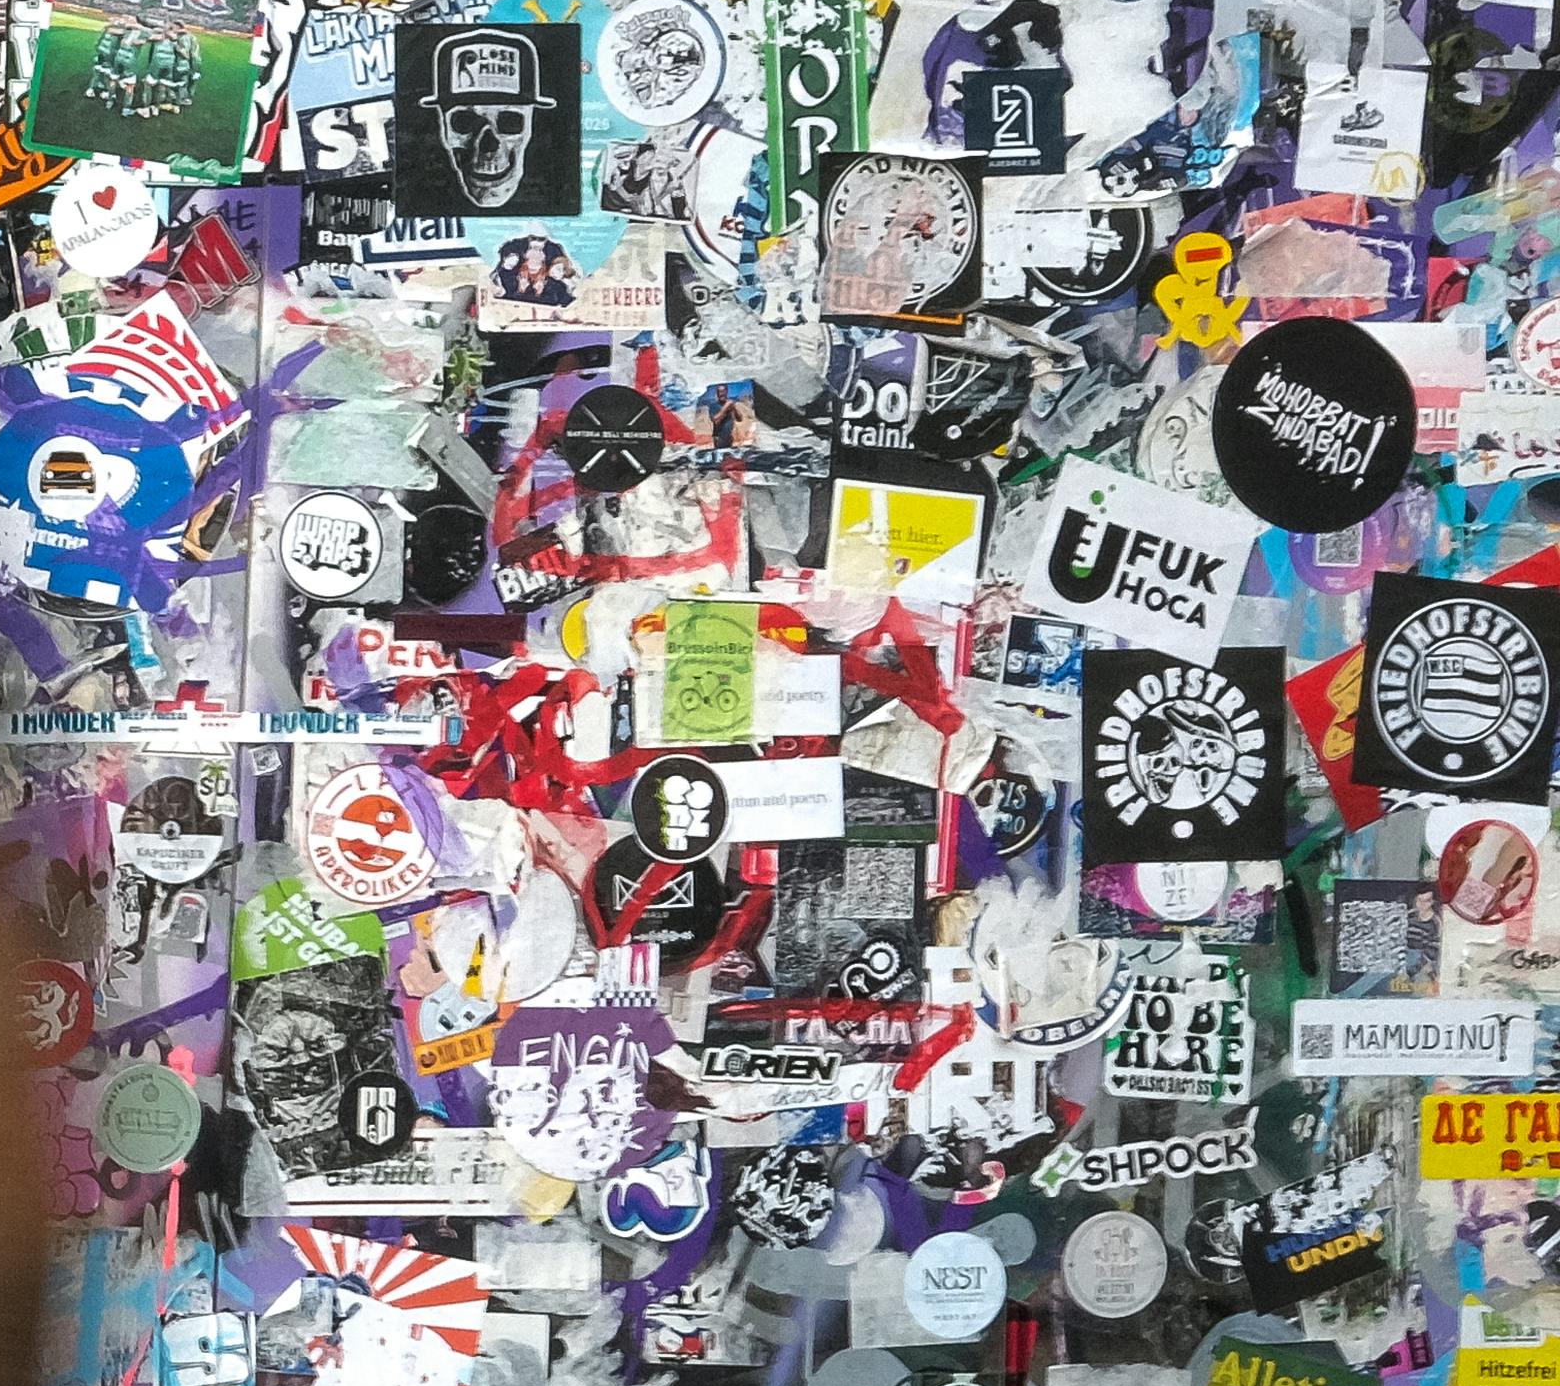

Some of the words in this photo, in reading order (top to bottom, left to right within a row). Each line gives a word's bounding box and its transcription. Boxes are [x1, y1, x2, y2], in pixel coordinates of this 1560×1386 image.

[1253, 367, 1369, 448] MOHOBBAT
[1115, 575, 1208, 630] HOCA
[1081, 1132, 1251, 1186] SHPOCK
[1478, 1359, 1558, 1380] Hitzefrei
